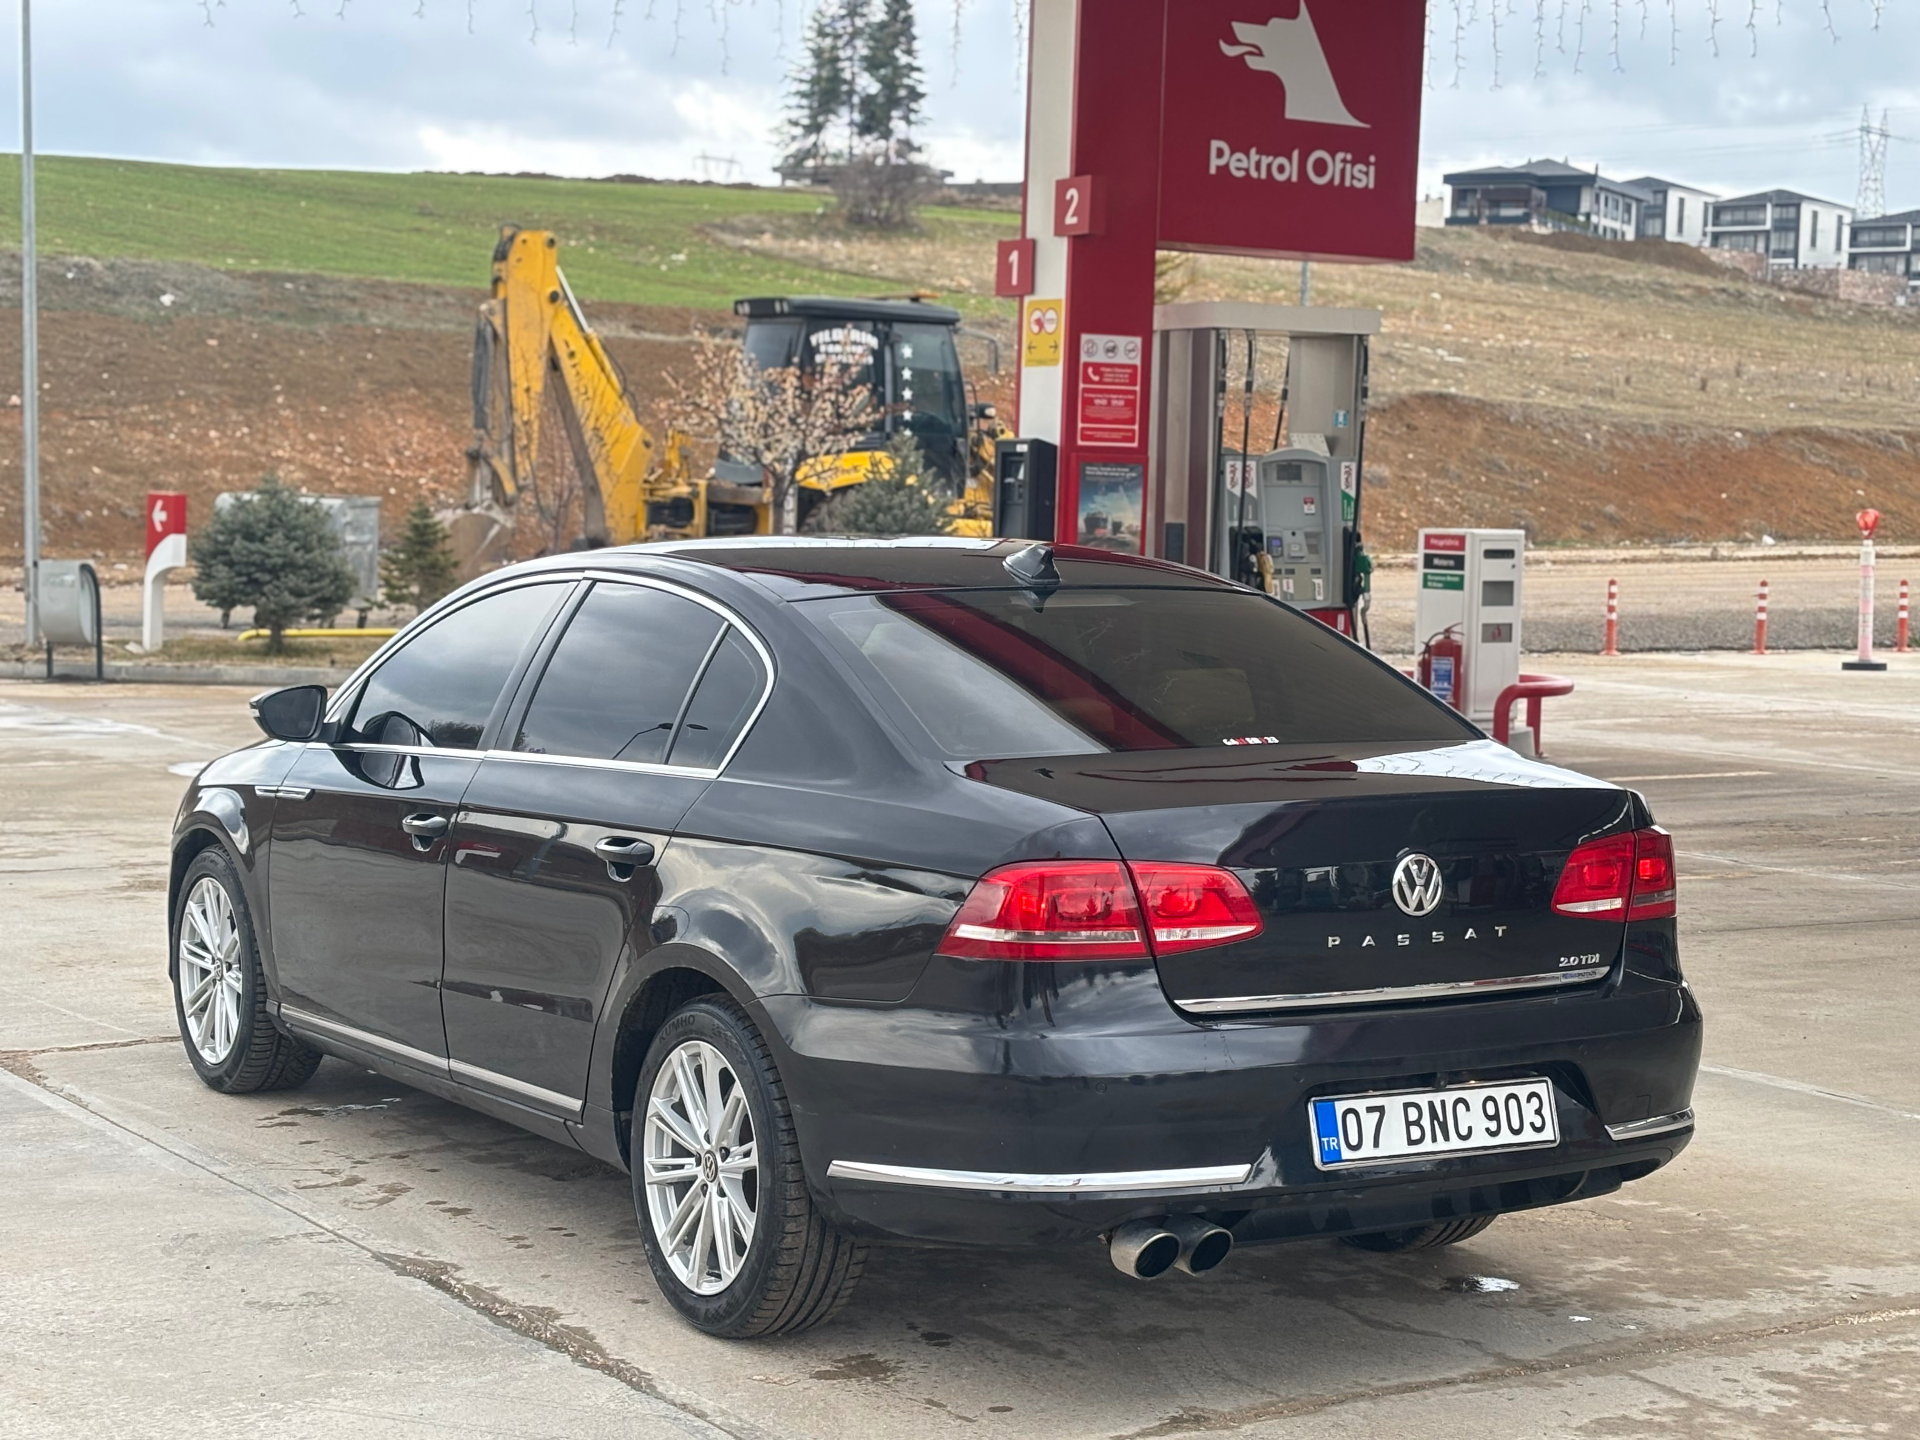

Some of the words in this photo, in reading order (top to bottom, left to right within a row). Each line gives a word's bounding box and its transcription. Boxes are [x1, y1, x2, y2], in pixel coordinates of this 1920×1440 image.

[1209, 139, 1299, 183] Petrol
[1306, 149, 1376, 189] Ofisi
[1064, 187, 1079, 225] 2
[1008, 249, 1019, 286] 1
[1327, 925, 1507, 948] PASSAT
[1580, 953, 1601, 965] TDI
[659, 1014, 696, 1043] KUMHO
[1341, 1104, 1386, 1152] 07
[1402, 1096, 1473, 1147] BNC
[1481, 1091, 1546, 1138] 903
[1321, 1136, 1339, 1151] TR
